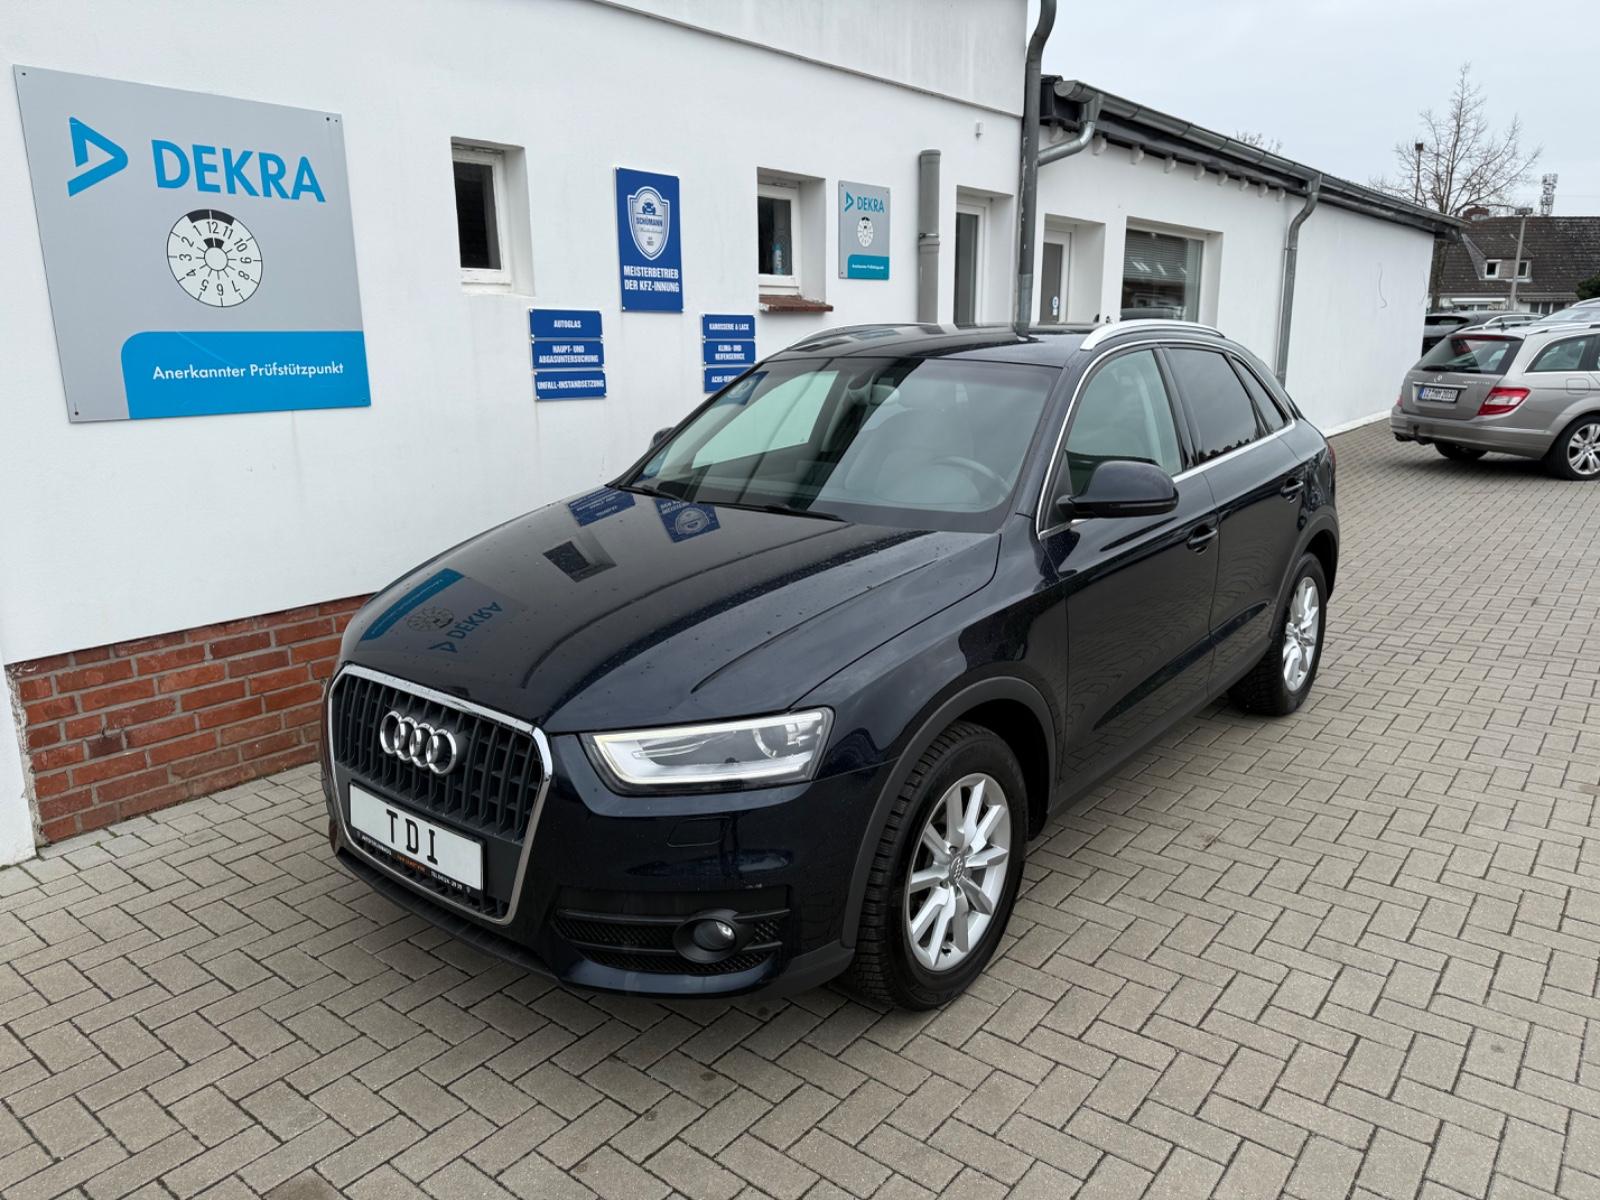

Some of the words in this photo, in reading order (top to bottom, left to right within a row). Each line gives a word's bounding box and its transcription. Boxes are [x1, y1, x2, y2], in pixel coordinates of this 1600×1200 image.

[151, 139, 326, 203] DEKRA
[857, 197, 884, 213] DEKRA
[193, 225, 202, 236] 1
[206, 221, 220, 234] 12
[223, 226, 233, 239] 11
[181, 236, 194, 247] 2
[234, 238, 248, 252] 10
[179, 253, 192, 261] 3
[186, 268, 196, 277] 4
[238, 270, 250, 280] 8
[624, 265, 679, 279] MEISTERBETRIEB
[200, 279, 209, 292] 5
[216, 283, 224, 296] 6
[231, 280, 240, 293] 7
[624, 280, 638, 290] DER
[640, 280, 680, 292] KFZ-INNUNG
[553, 320, 582, 328] AUTOGLAS
[538, 354, 599, 363] ABGASUNTERSUCHUNG
[152, 365, 246, 380] Anerkannter
[250, 362, 344, 379] Prüfstützpunkt
[537, 379, 605, 390] UNFALL-INSTANDSETZUNG
[386, 808, 438, 865] TDI
